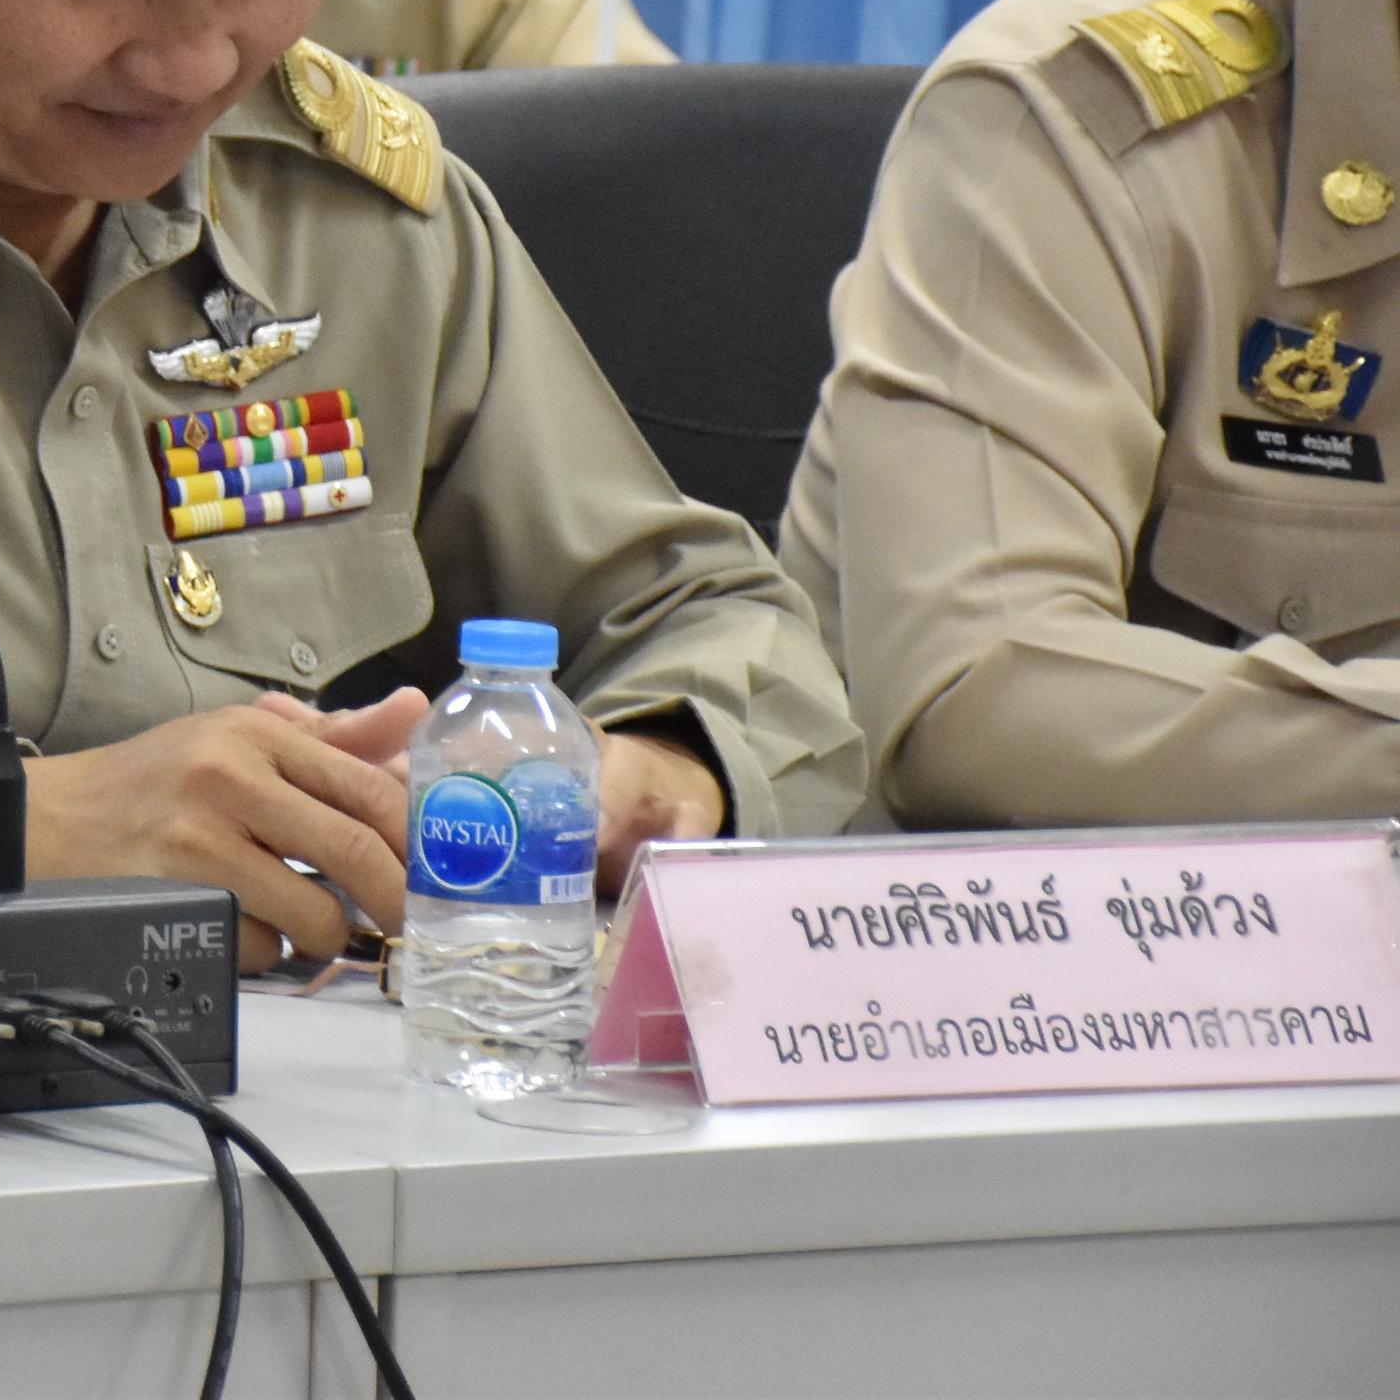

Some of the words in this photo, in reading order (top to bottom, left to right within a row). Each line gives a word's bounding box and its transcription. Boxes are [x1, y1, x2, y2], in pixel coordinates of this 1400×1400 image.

[422, 816, 510, 847] CRYSTAL
[143, 921, 225, 951] NPE
[791, 874, 1070, 951] นายศิริพันธ์
[1105, 870, 1280, 962] ขุ่มด้วง
[765, 992, 1374, 1065] นายอำเภอเมืองมหาสารคาม
